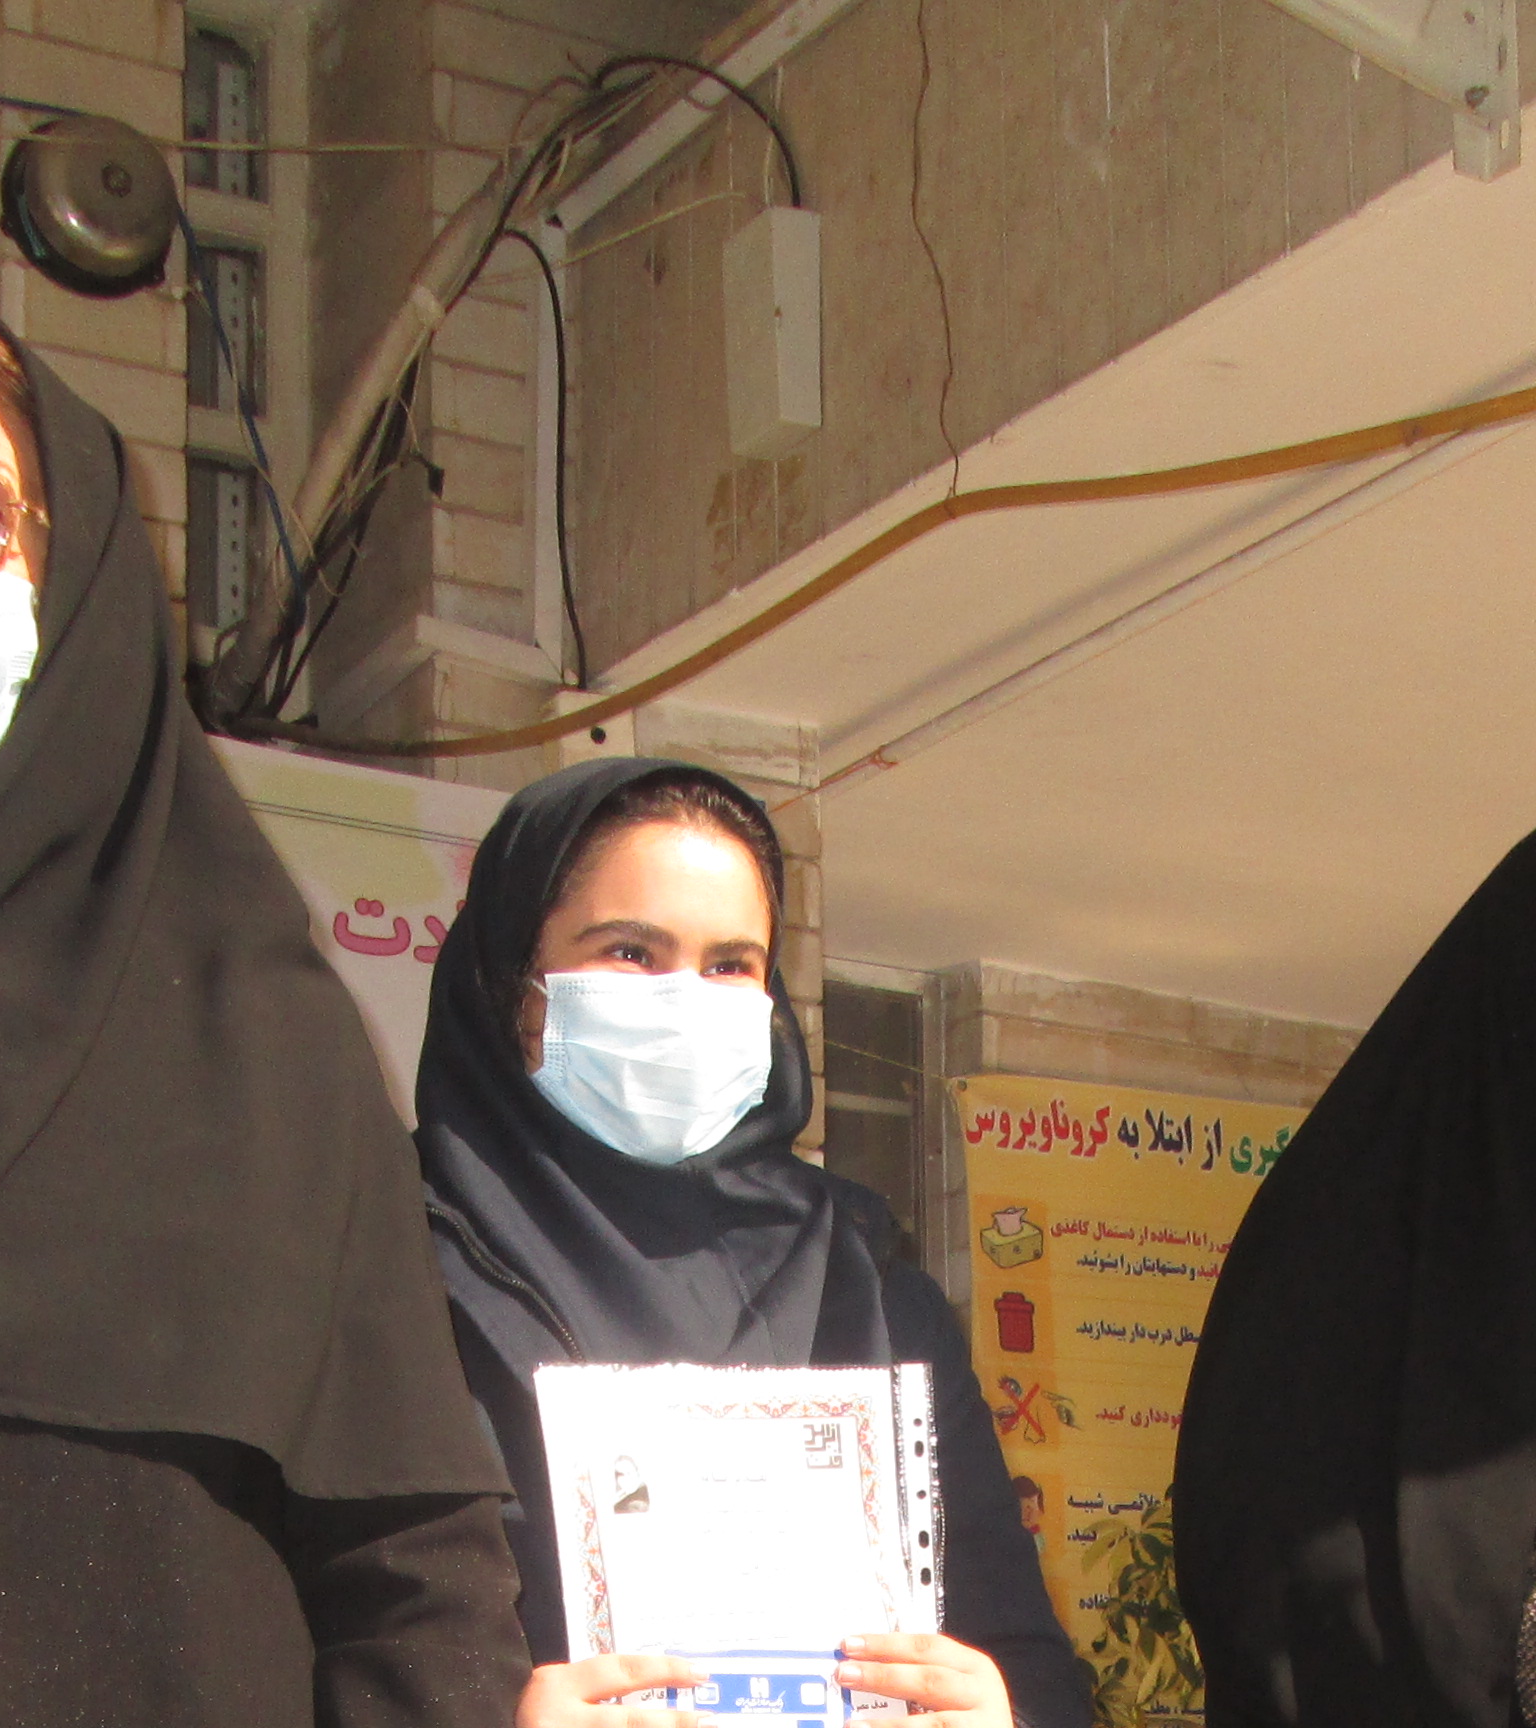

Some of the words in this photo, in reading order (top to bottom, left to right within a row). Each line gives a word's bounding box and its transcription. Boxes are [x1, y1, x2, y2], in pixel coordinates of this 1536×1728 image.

[965, 1099, 1111, 1158] کروناویروس
[1117, 1117, 1139, 1160] به
[1145, 1108, 1193, 1166] ابتلا
[1200, 1117, 1222, 1171] از
[1051, 1218, 1090, 1238] کاغذی
[1093, 1222, 1135, 1241] دستمال
